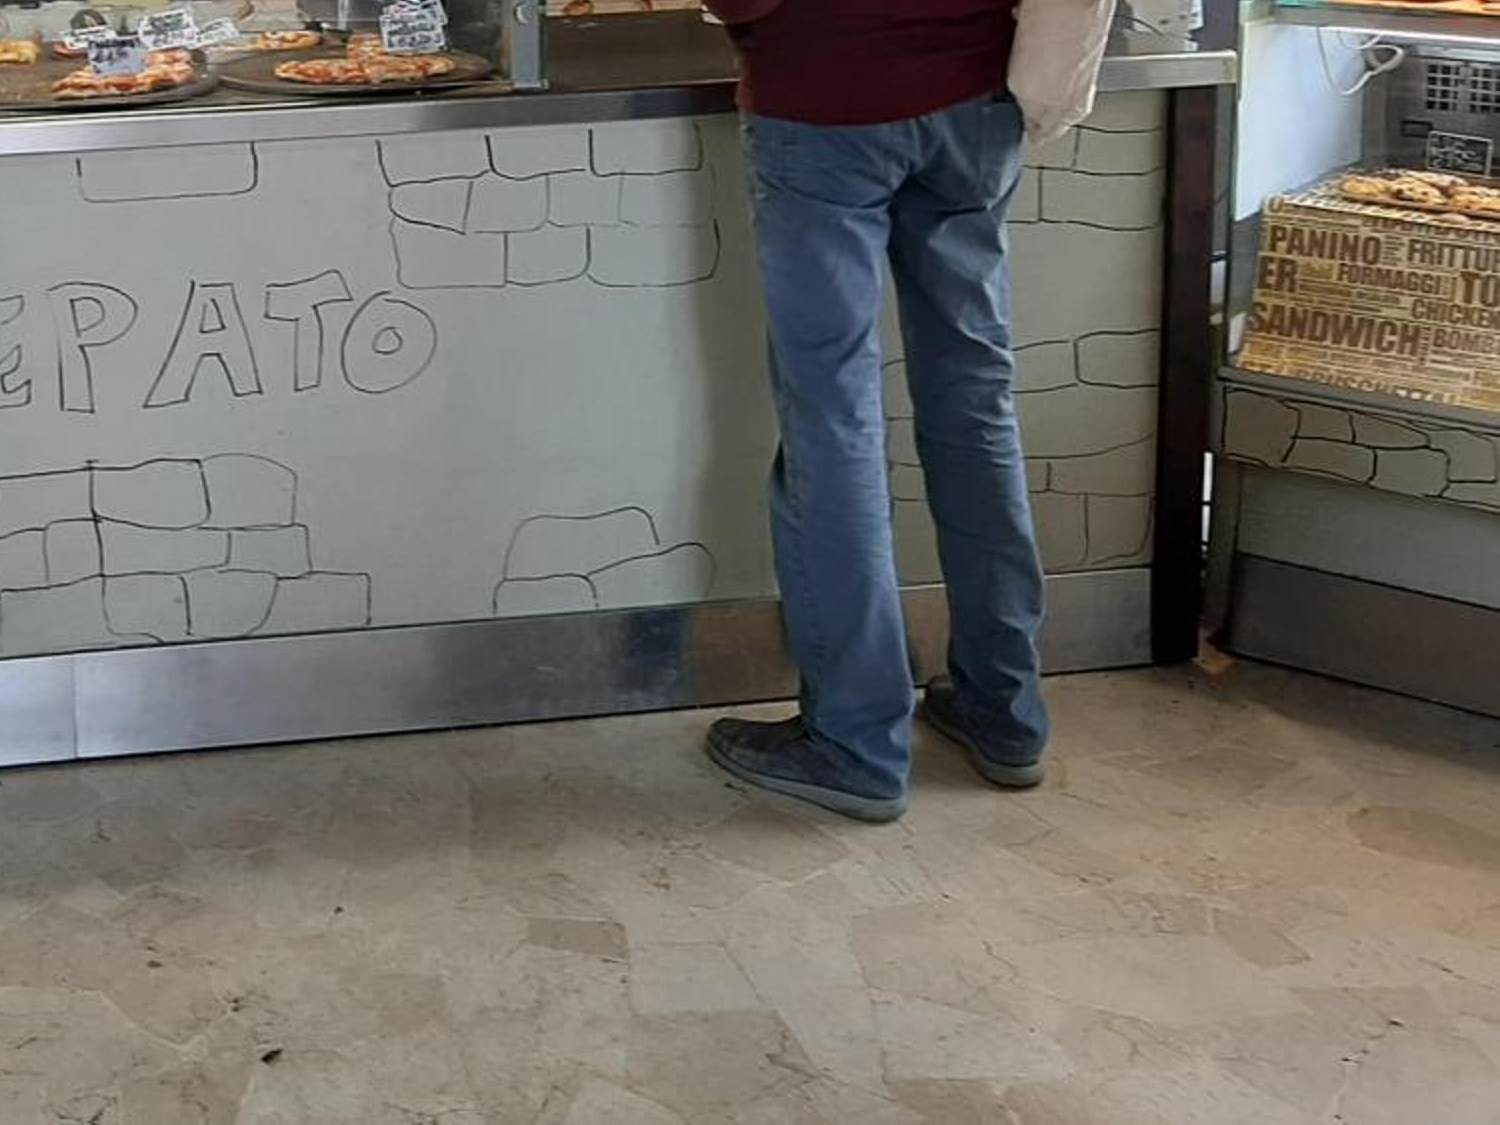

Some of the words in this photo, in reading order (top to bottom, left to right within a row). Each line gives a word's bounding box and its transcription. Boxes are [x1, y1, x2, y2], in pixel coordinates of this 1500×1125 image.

[1269, 225, 1380, 265] PANINO
[1337, 262, 1441, 295] FORMAGGI
[1250, 302, 1420, 356] SANDWICH
